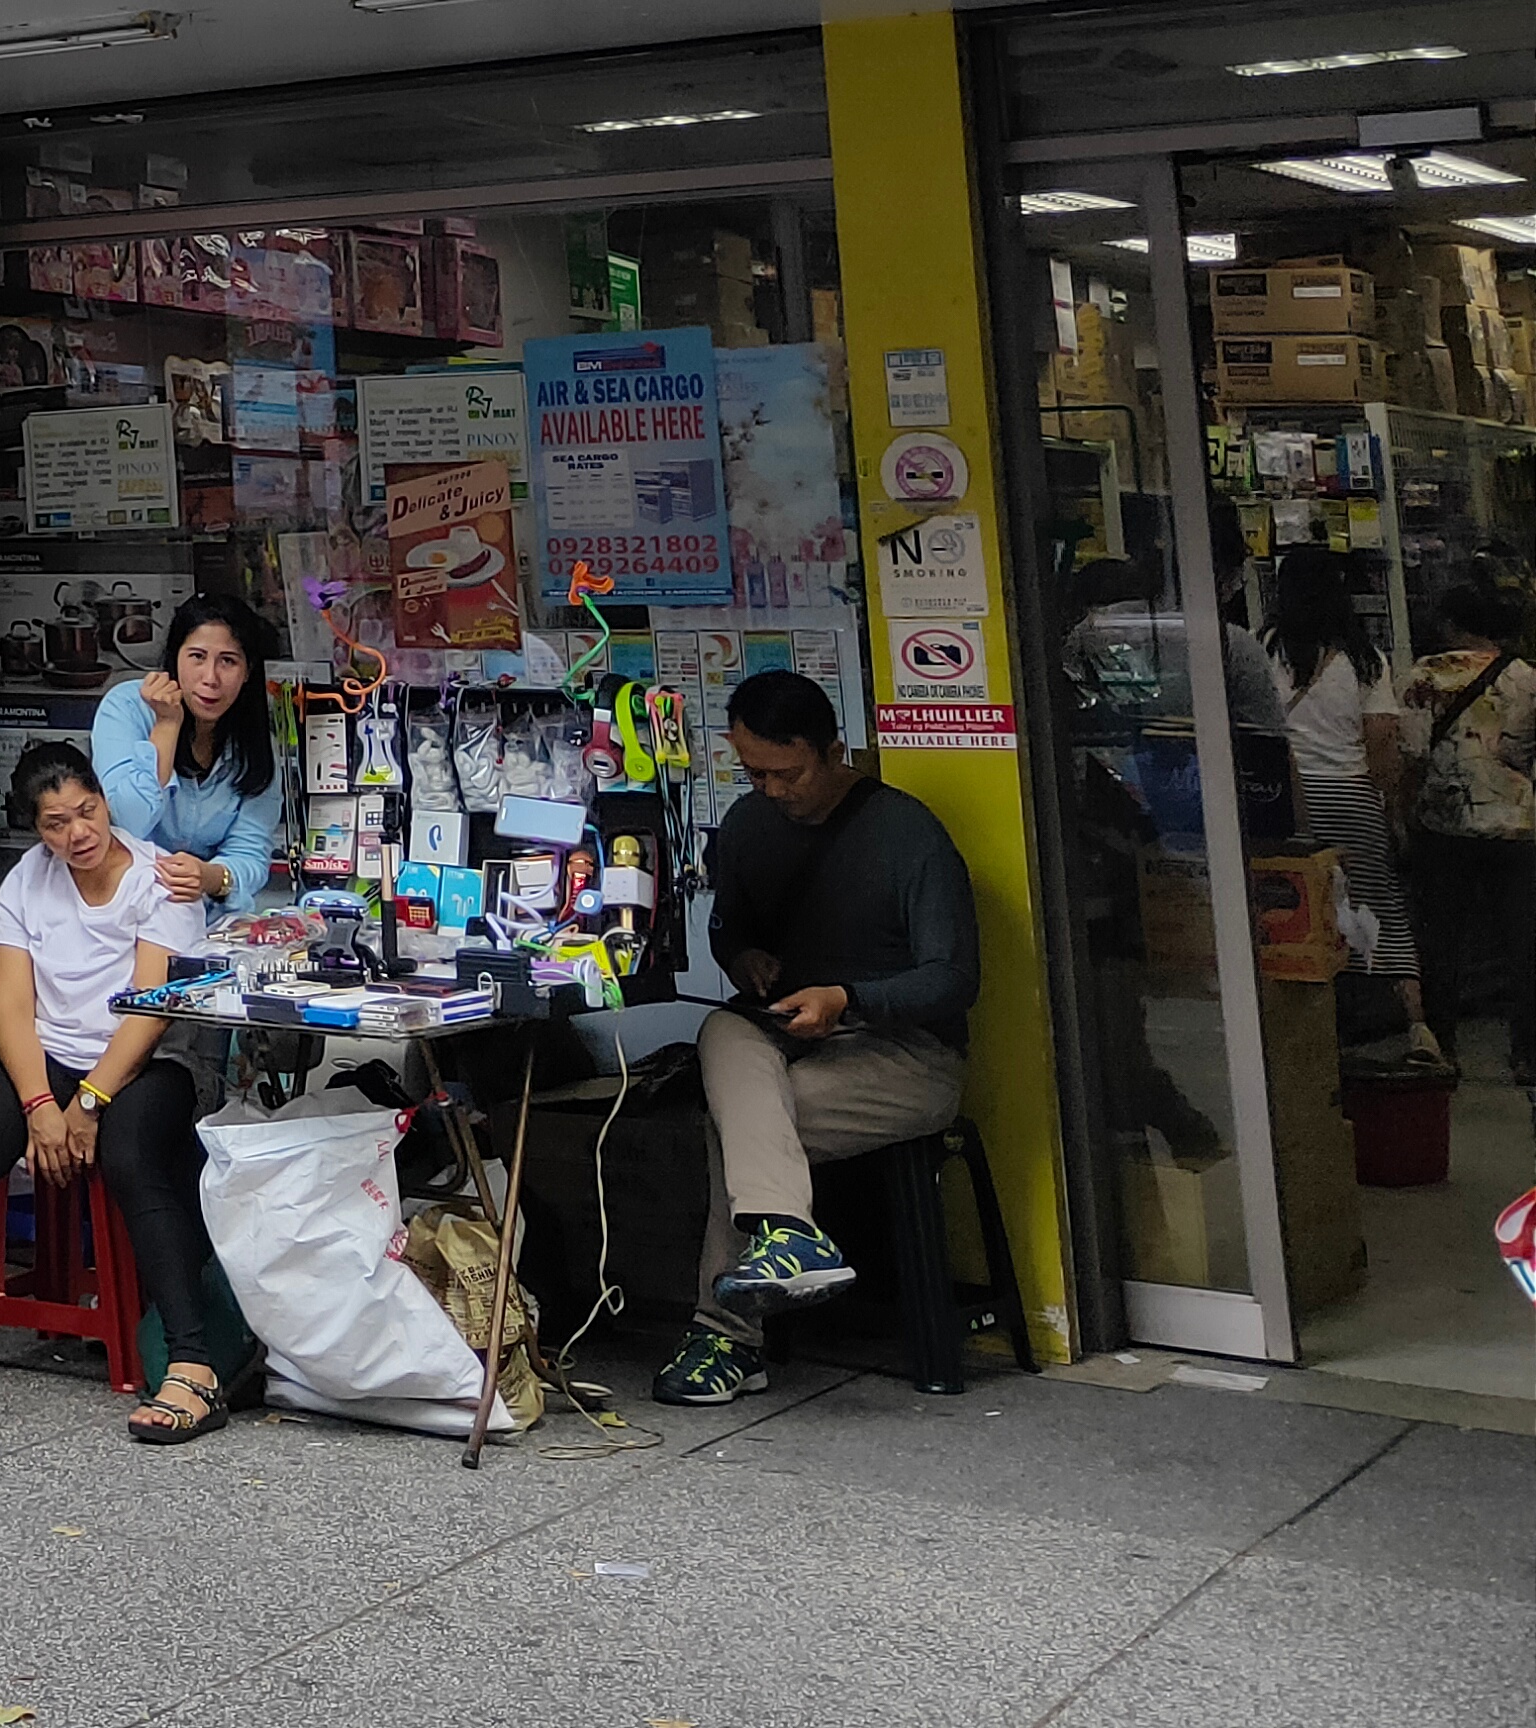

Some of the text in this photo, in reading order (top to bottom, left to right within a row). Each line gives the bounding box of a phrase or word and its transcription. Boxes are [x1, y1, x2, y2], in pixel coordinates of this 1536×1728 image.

[536, 373, 705, 407] AIR SEA CARGO
[539, 405, 706, 446] AVAILABLE HERE
[466, 432, 519, 447] PINOY
[391, 482, 464, 524] Delicate
[458, 485, 506, 518] Juicy
[545, 534, 718, 555] 0928321802
[880, 733, 1010, 747] AVAILABLE HERE
[304, 858, 348, 872] SanDisk
